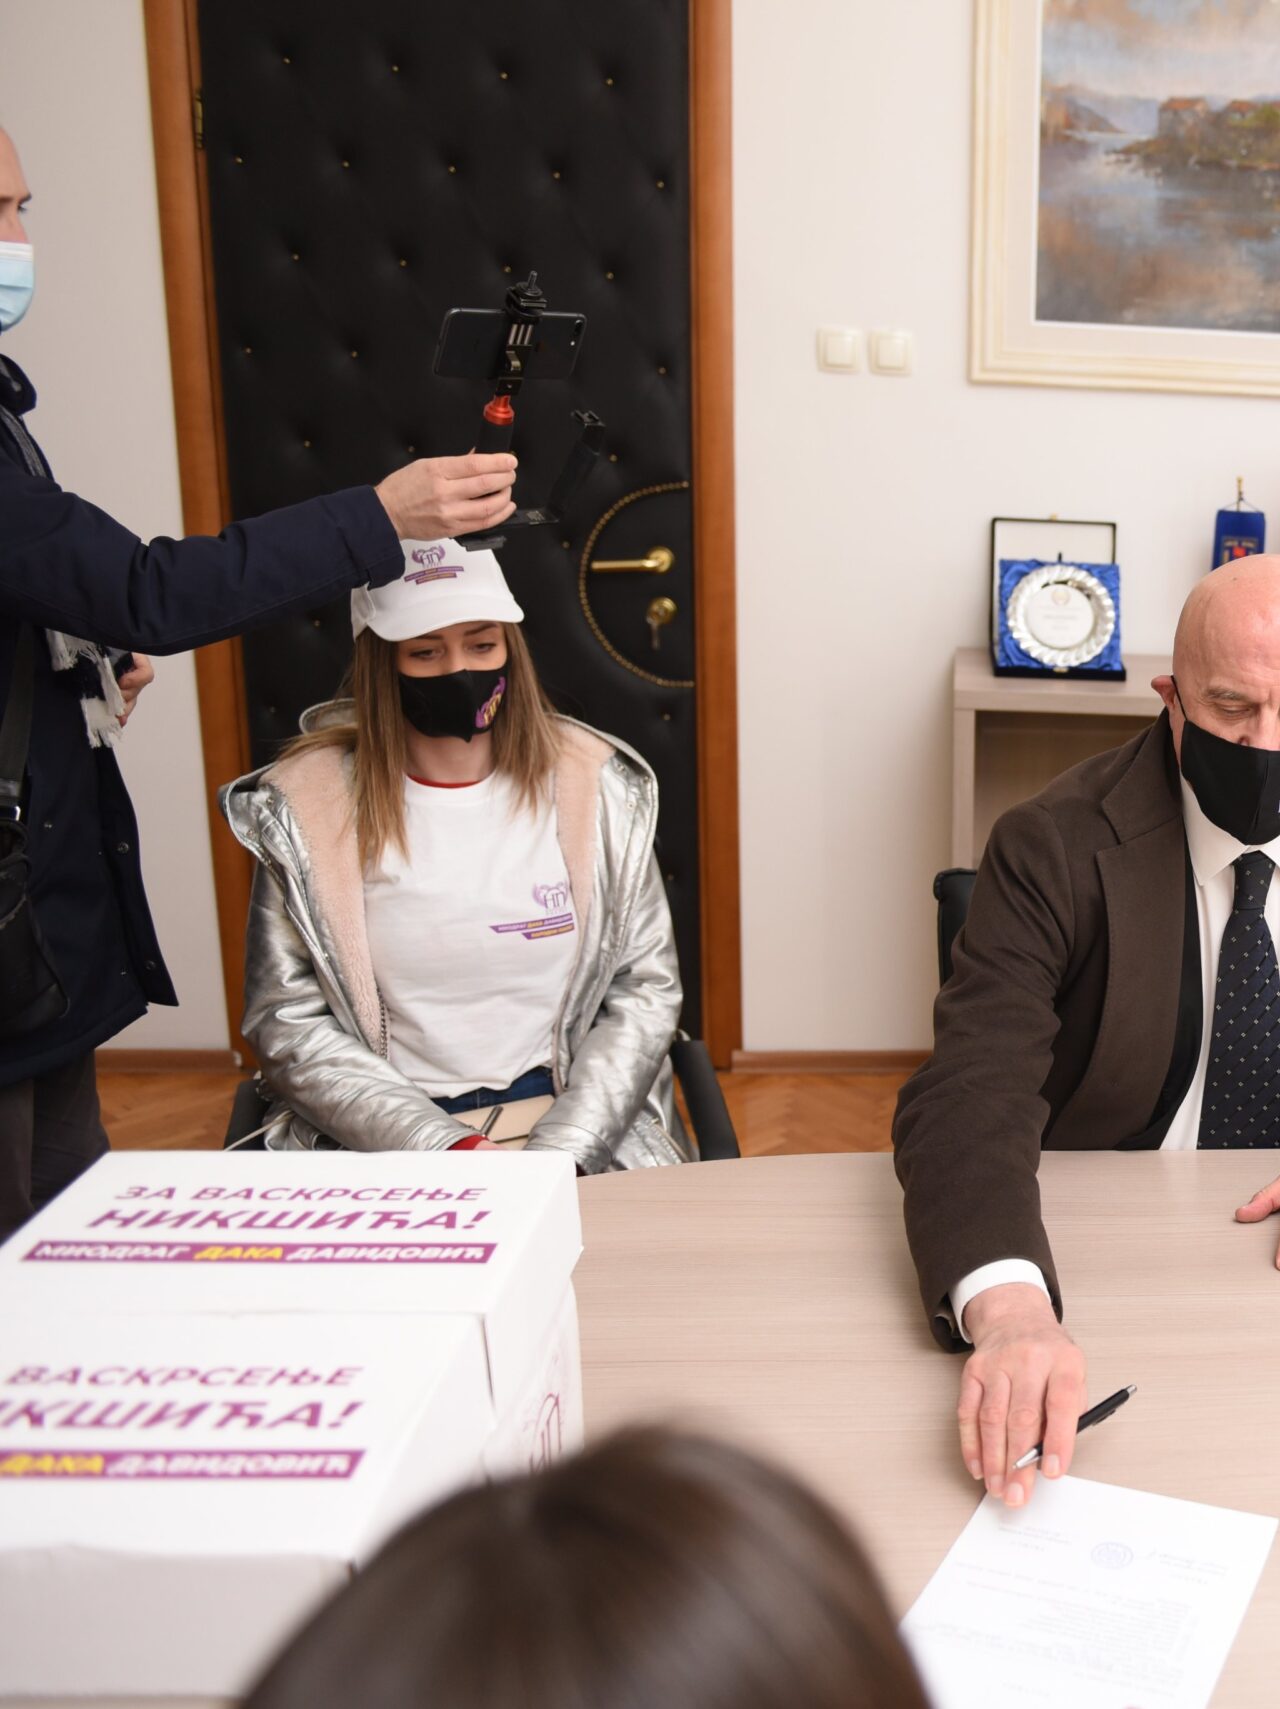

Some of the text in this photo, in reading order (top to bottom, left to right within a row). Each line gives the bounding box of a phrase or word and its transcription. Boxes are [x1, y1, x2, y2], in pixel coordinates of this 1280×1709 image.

[114, 1186, 488, 1201] ЗА ВАСКРСЕЊЕ
[84, 1208, 493, 1230] НИКШИЋА!
[33, 1244, 488, 1262] МИОДРАГ ДАКА ДАВИДОВИЋ
[4, 1366, 365, 1387] ВАСКРСЕЊЕ
